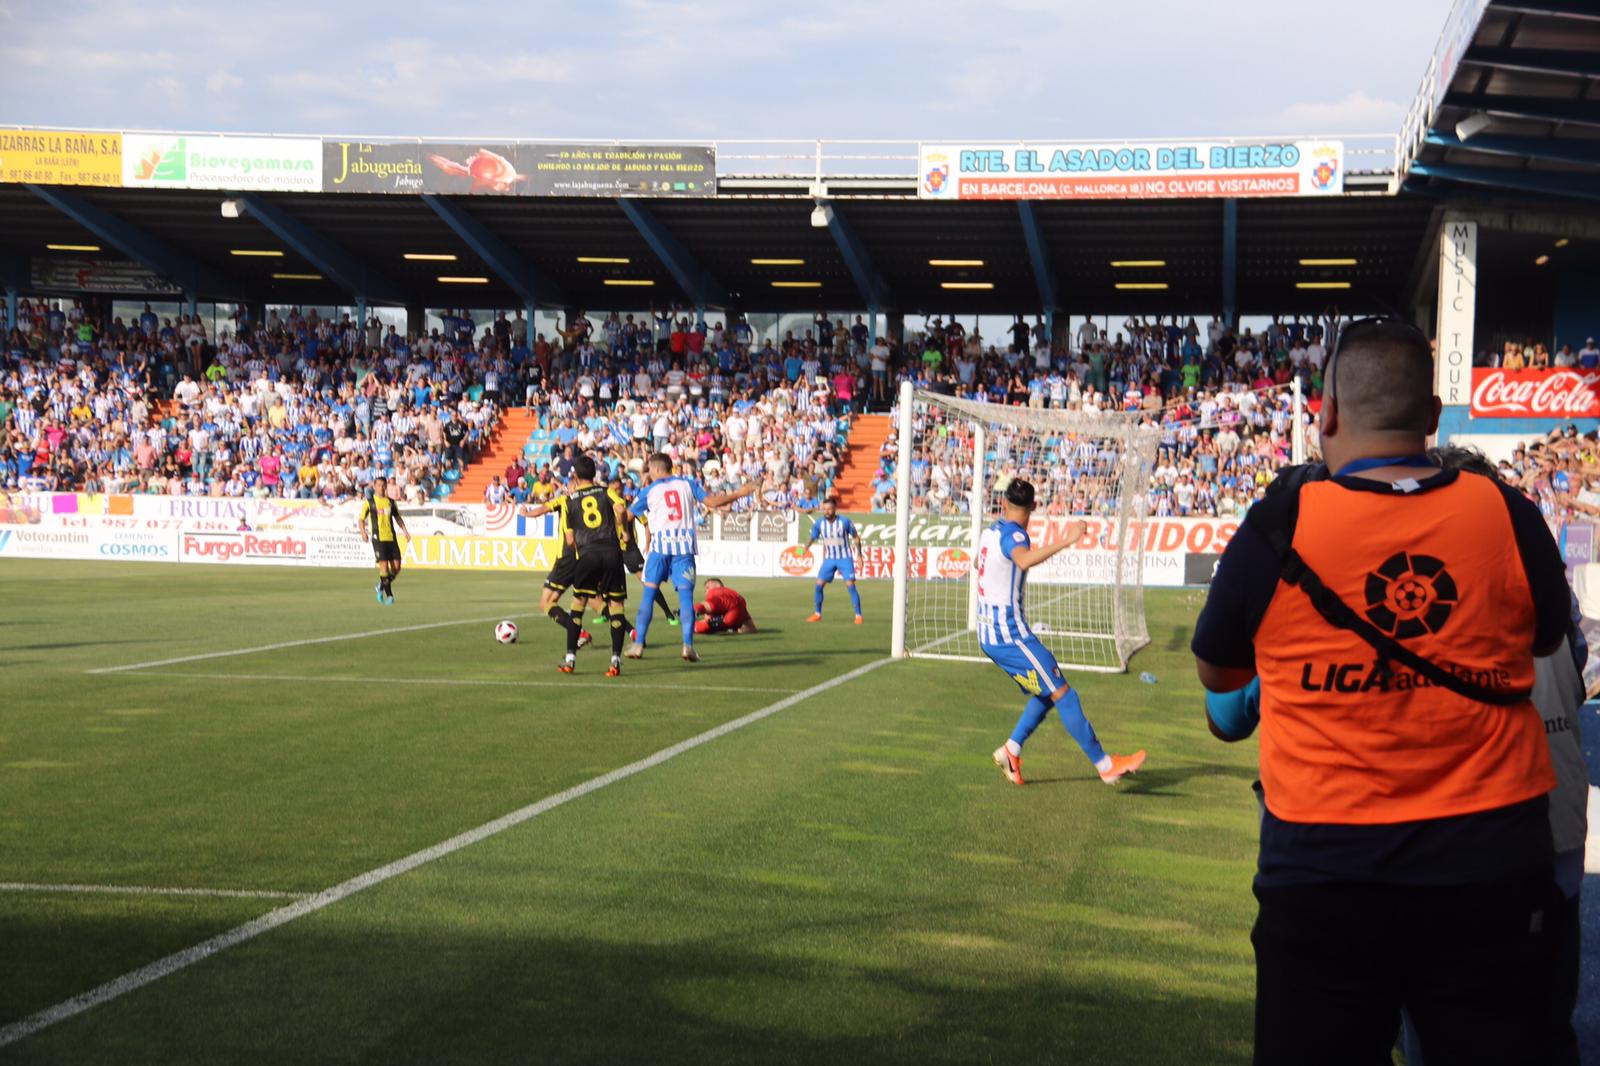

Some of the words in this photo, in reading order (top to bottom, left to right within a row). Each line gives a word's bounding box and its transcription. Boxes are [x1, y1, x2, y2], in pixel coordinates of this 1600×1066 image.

[48, 137, 62, 152] LA
[65, 134, 99, 158] BAÑA,
[101, 139, 122, 155] S.A.
[360, 142, 372, 153] La
[572, 150, 591, 159] AÑOS
[648, 152, 653, 160] Y
[190, 152, 314, 174] Biovegamasa
[333, 143, 423, 184] Jabugueña
[573, 163, 582, 171] LO
[612, 163, 621, 171] DE
[960, 150, 1009, 173] RTE.
[1015, 150, 1044, 173] EL
[1049, 148, 1151, 172] ASADOR
[1157, 146, 1204, 170] DEL
[1210, 143, 1300, 169] BIERZO
[257, 174, 271, 184] de
[394, 175, 424, 189] Jabugo
[961, 183, 979, 195] EN
[981, 183, 1057, 196] BARCELONA
[1074, 184, 1127, 194] MALLORCA
[1145, 181, 1165, 193] NO
[1168, 179, 1215, 192] OLVIDE
[1218, 178, 1295, 191] VISITARNOS
[1452, 223, 1468, 312] MUSIC
[1448, 333, 1463, 402] TOUR
[1473, 371, 1600, 413] Coca-Cola
[170, 500, 247, 518] FRUTAS
[581, 495, 602, 529] 8
[664, 490, 683, 521] 9
[102, 518, 138, 528] 987
[146, 519, 183, 529] 077
[724, 513, 748, 527] AC
[761, 514, 785, 528] AC
[16, 529, 89, 544] Votorantim
[99, 543, 169, 557] COSMOS
[401, 538, 549, 568] ALIMERKA
[699, 545, 767, 566] Prado
[780, 553, 813, 568] ibsa
[1301, 662, 1390, 693] LIGA
